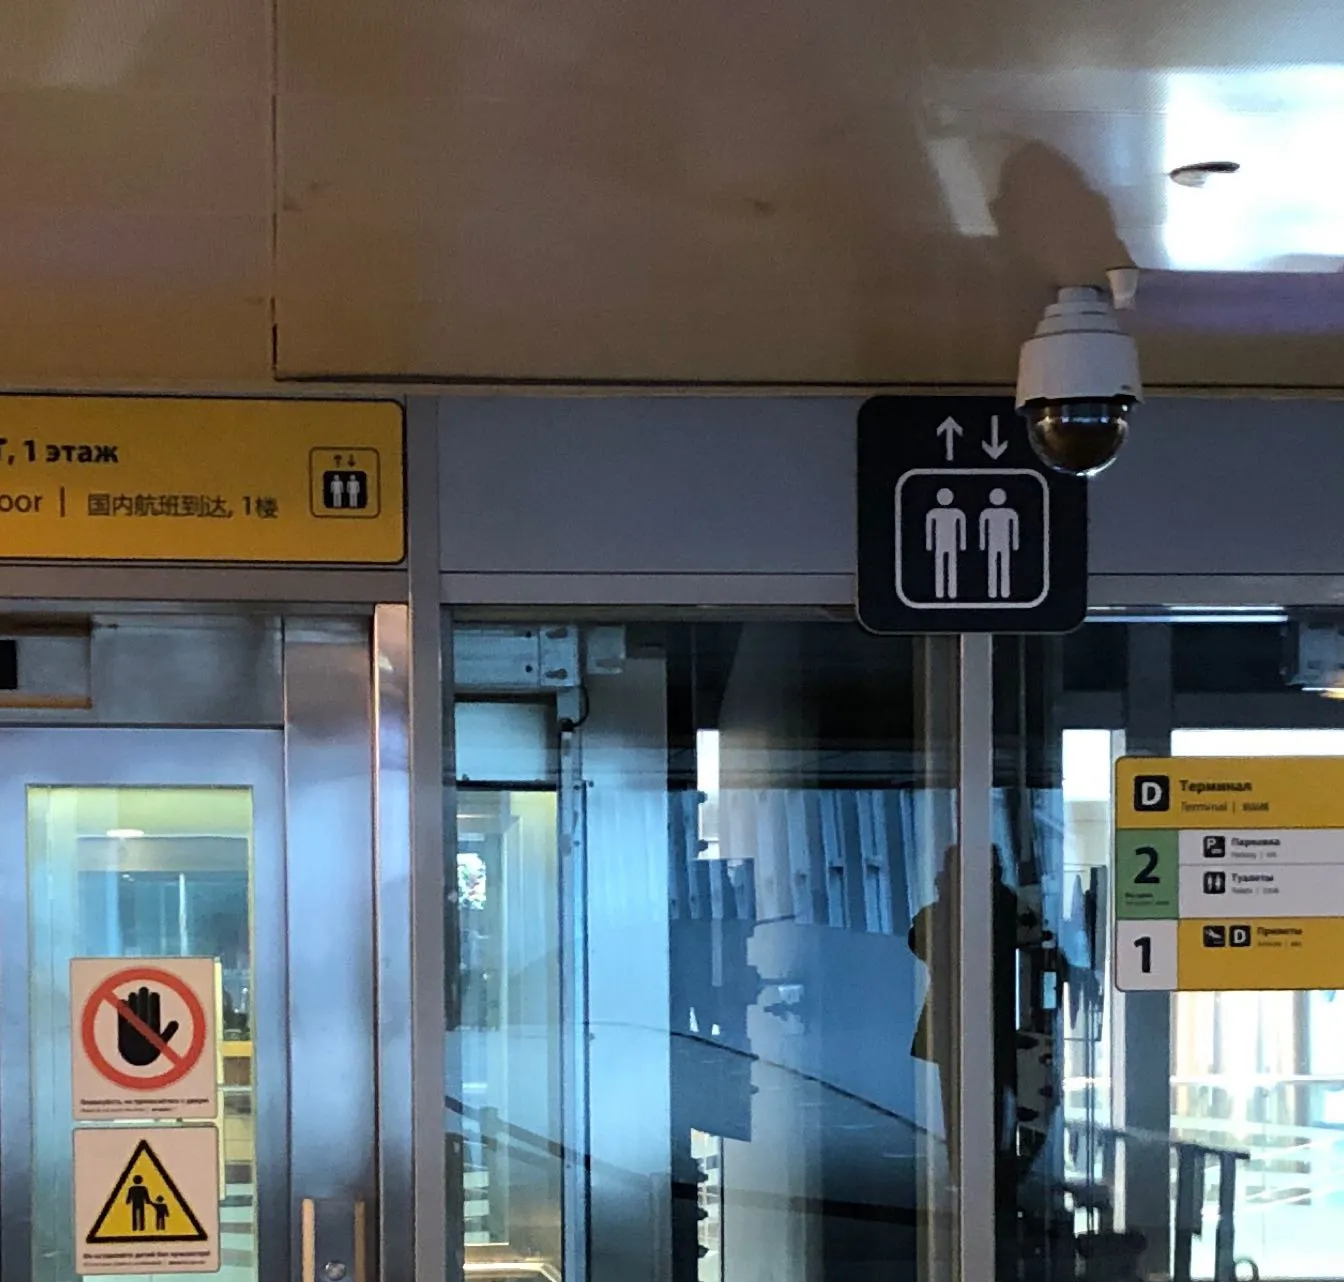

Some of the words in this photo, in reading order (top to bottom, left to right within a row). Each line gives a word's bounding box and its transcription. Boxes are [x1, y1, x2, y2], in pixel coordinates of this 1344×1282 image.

[23, 439, 36, 462] 1
[45, 444, 119, 464] этаж
[1141, 781, 1163, 806] D
[1133, 846, 1161, 884] 2
[1233, 928, 1247, 944] D
[1133, 936, 1151, 974] 1
